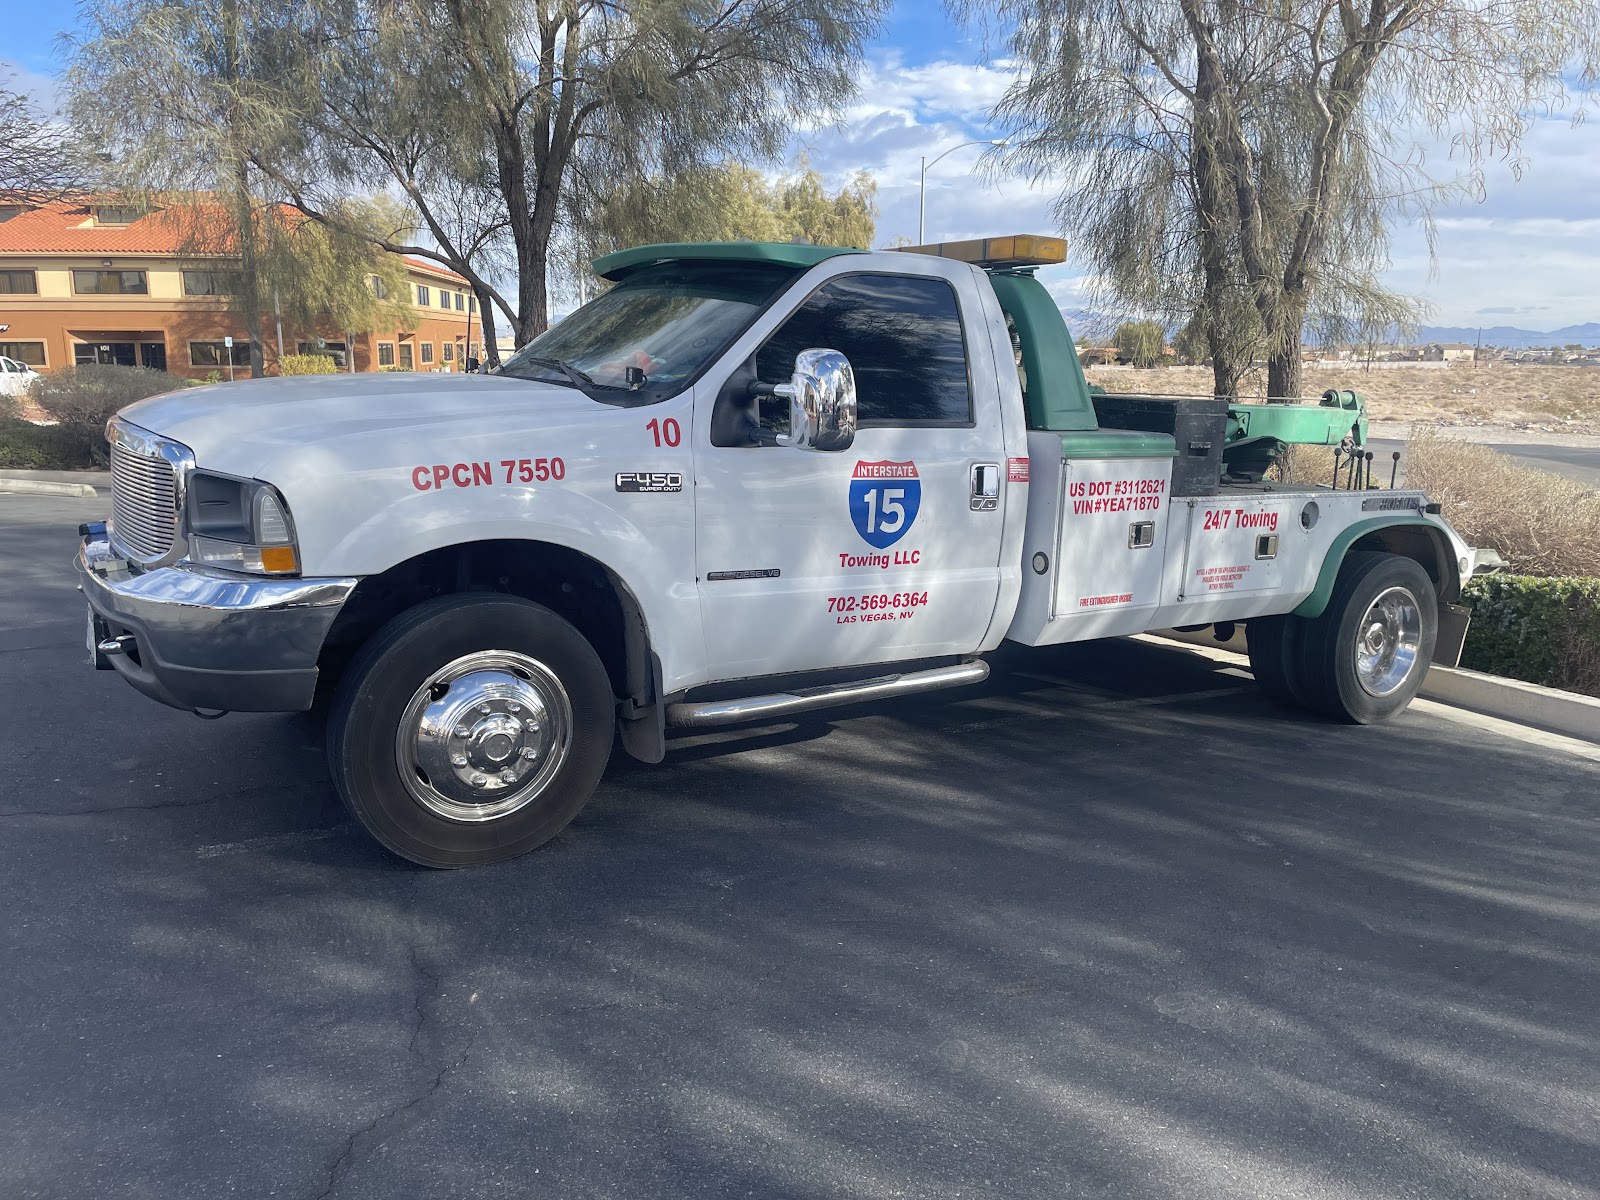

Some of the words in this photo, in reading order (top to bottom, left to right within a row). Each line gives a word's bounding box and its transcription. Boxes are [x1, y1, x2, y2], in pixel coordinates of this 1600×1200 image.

[646, 417, 681, 448] 10
[411, 461, 493, 491] CPCN
[501, 457, 566, 484] 7550
[857, 465, 914, 477] INTERSTATE
[1069, 482, 1085, 498] US
[1088, 481, 1112, 496] DOT
[1114, 479, 1165, 496] #3112621
[863, 488, 906, 534] 15
[1073, 496, 1160, 515] VIN#YEA71870
[1203, 509, 1232, 530] 24/7
[1235, 508, 1278, 531] Towing
[839, 553, 890, 570] Towing
[894, 550, 921, 565] LLC
[767, 569, 780, 577] V8
[827, 591, 928, 612] 702-569-6364
[836, 615, 857, 624] LAS
[860, 612, 896, 623] VEGAS,
[899, 611, 914, 619] NV
